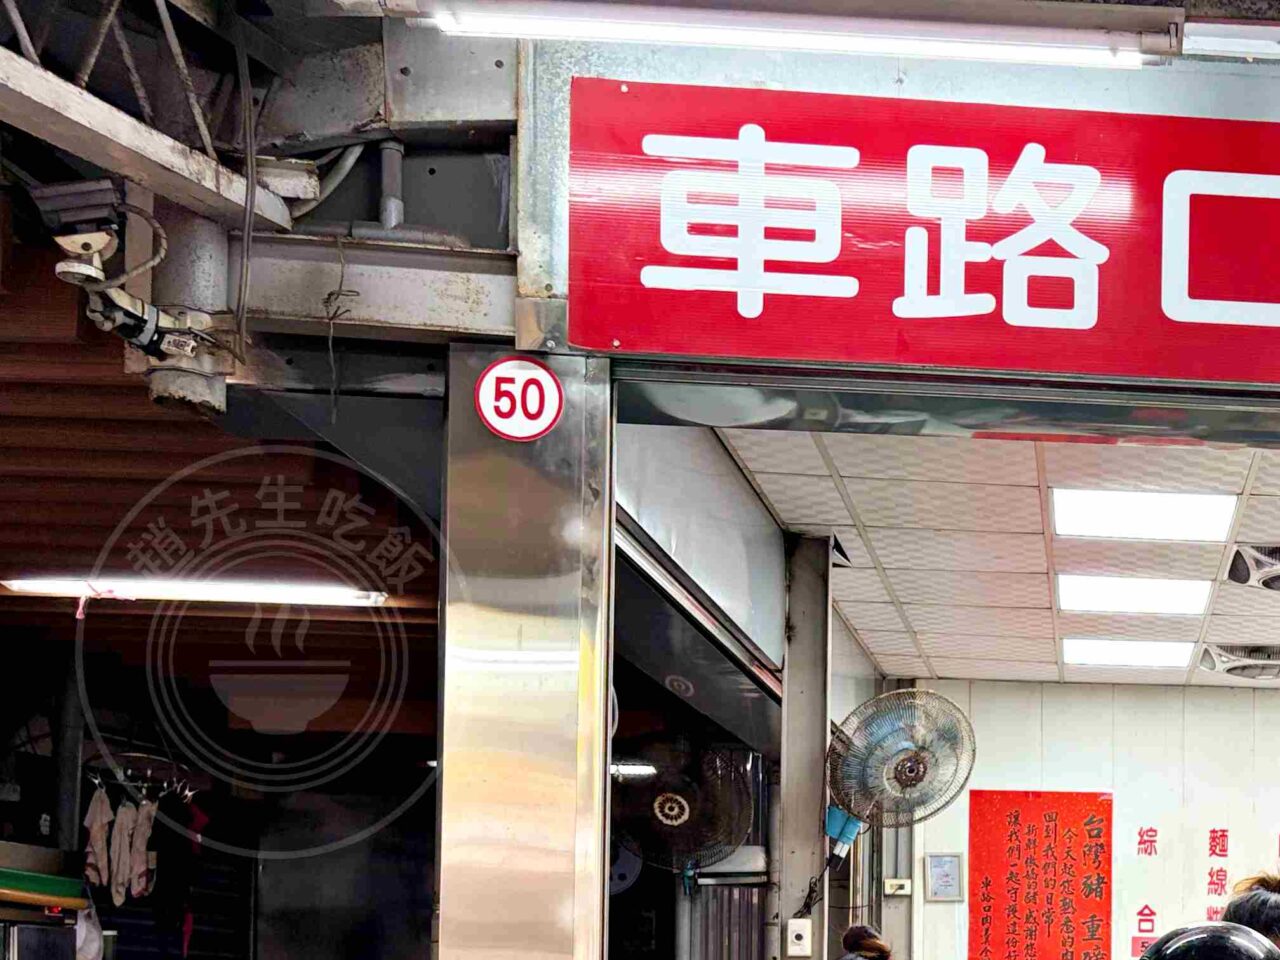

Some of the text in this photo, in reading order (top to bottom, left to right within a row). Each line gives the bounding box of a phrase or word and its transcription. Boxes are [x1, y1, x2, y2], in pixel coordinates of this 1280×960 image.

[493, 376, 546, 421] 50
[1040, 811, 1059, 938] 回到我們的日常
[1080, 813, 1109, 901] 台灣豬
[1136, 826, 1159, 934] 綜合
